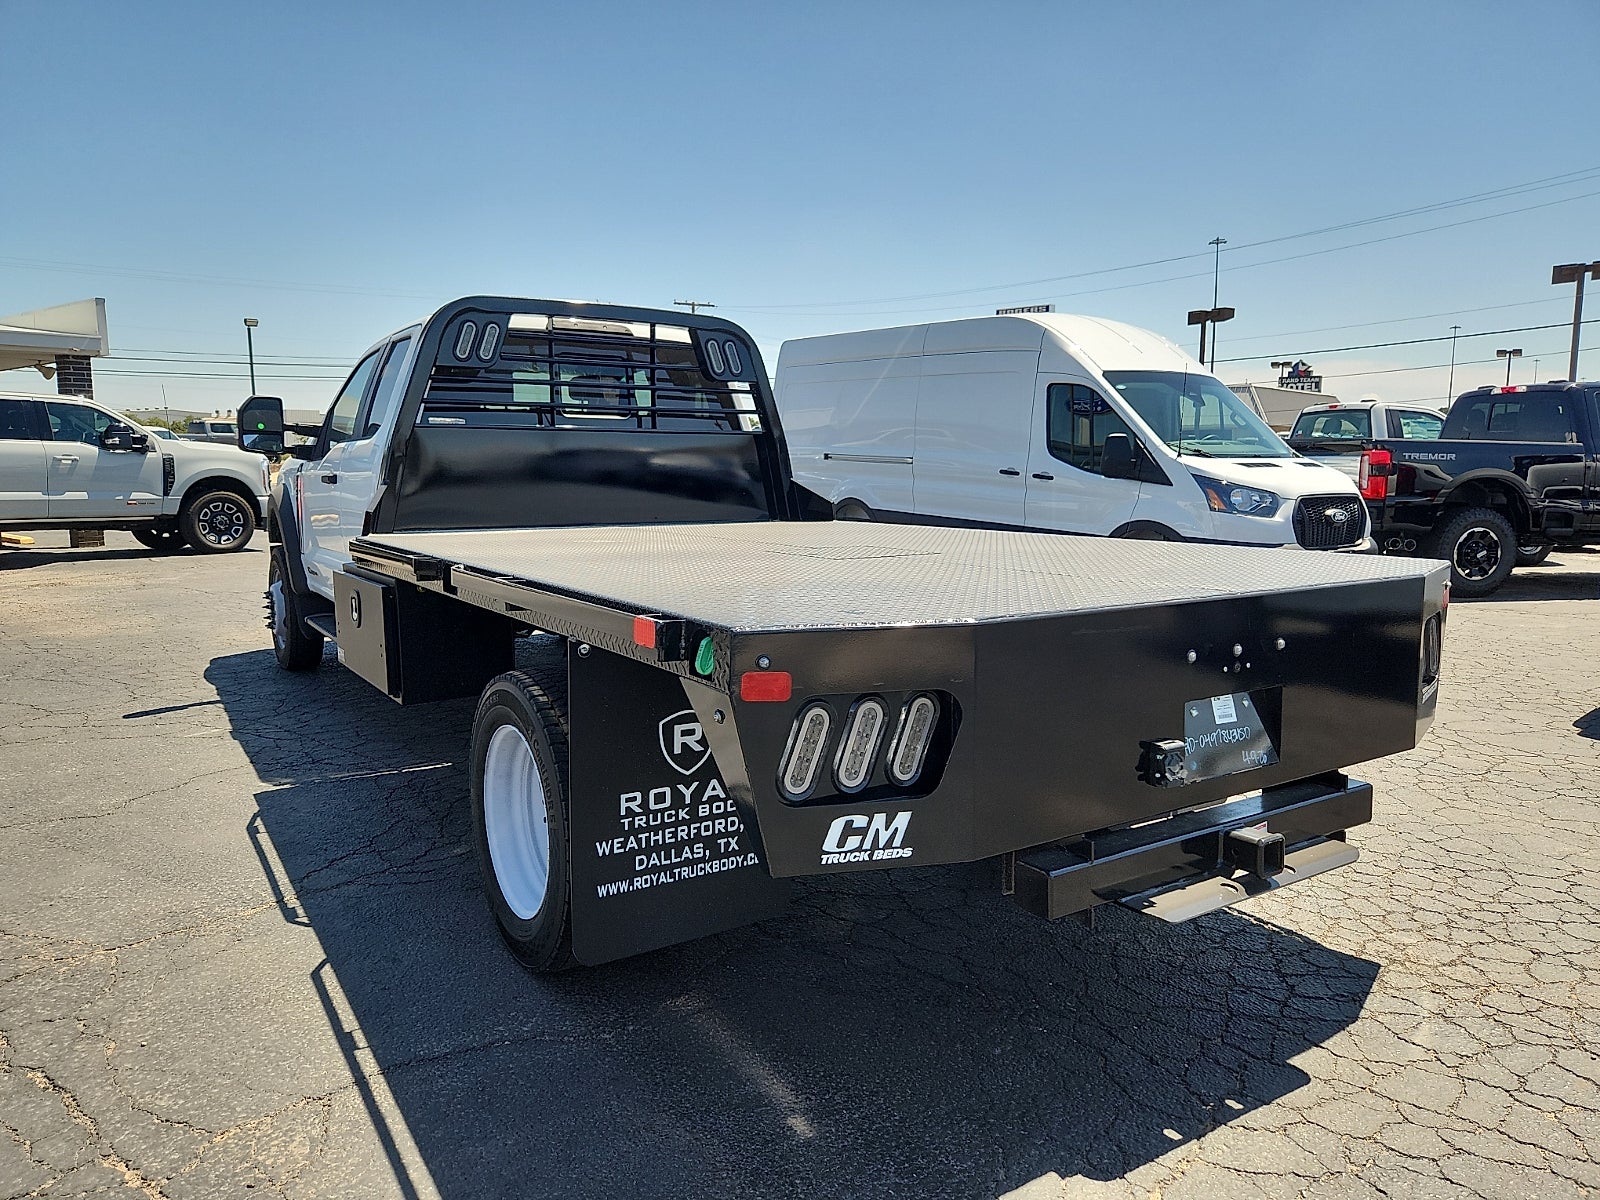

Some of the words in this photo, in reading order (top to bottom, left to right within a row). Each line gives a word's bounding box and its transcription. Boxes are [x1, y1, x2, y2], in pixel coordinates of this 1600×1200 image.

[1403, 452, 1456, 460] TREMOR
[674, 722, 704, 754] R
[620, 778, 727, 815] ROYA
[620, 807, 690, 830] TRUCK
[699, 800, 736, 817] BOD
[822, 811, 913, 852] CM
[596, 816, 744, 857] WEATHERFORD,
[635, 843, 710, 871] DALLAS,
[717, 836, 739, 853] TX
[820, 850, 871, 865] TRUCK
[872, 847, 913, 860] BEDS
[597, 853, 759, 898] WWW.ROYALTRUCKBODY.C
